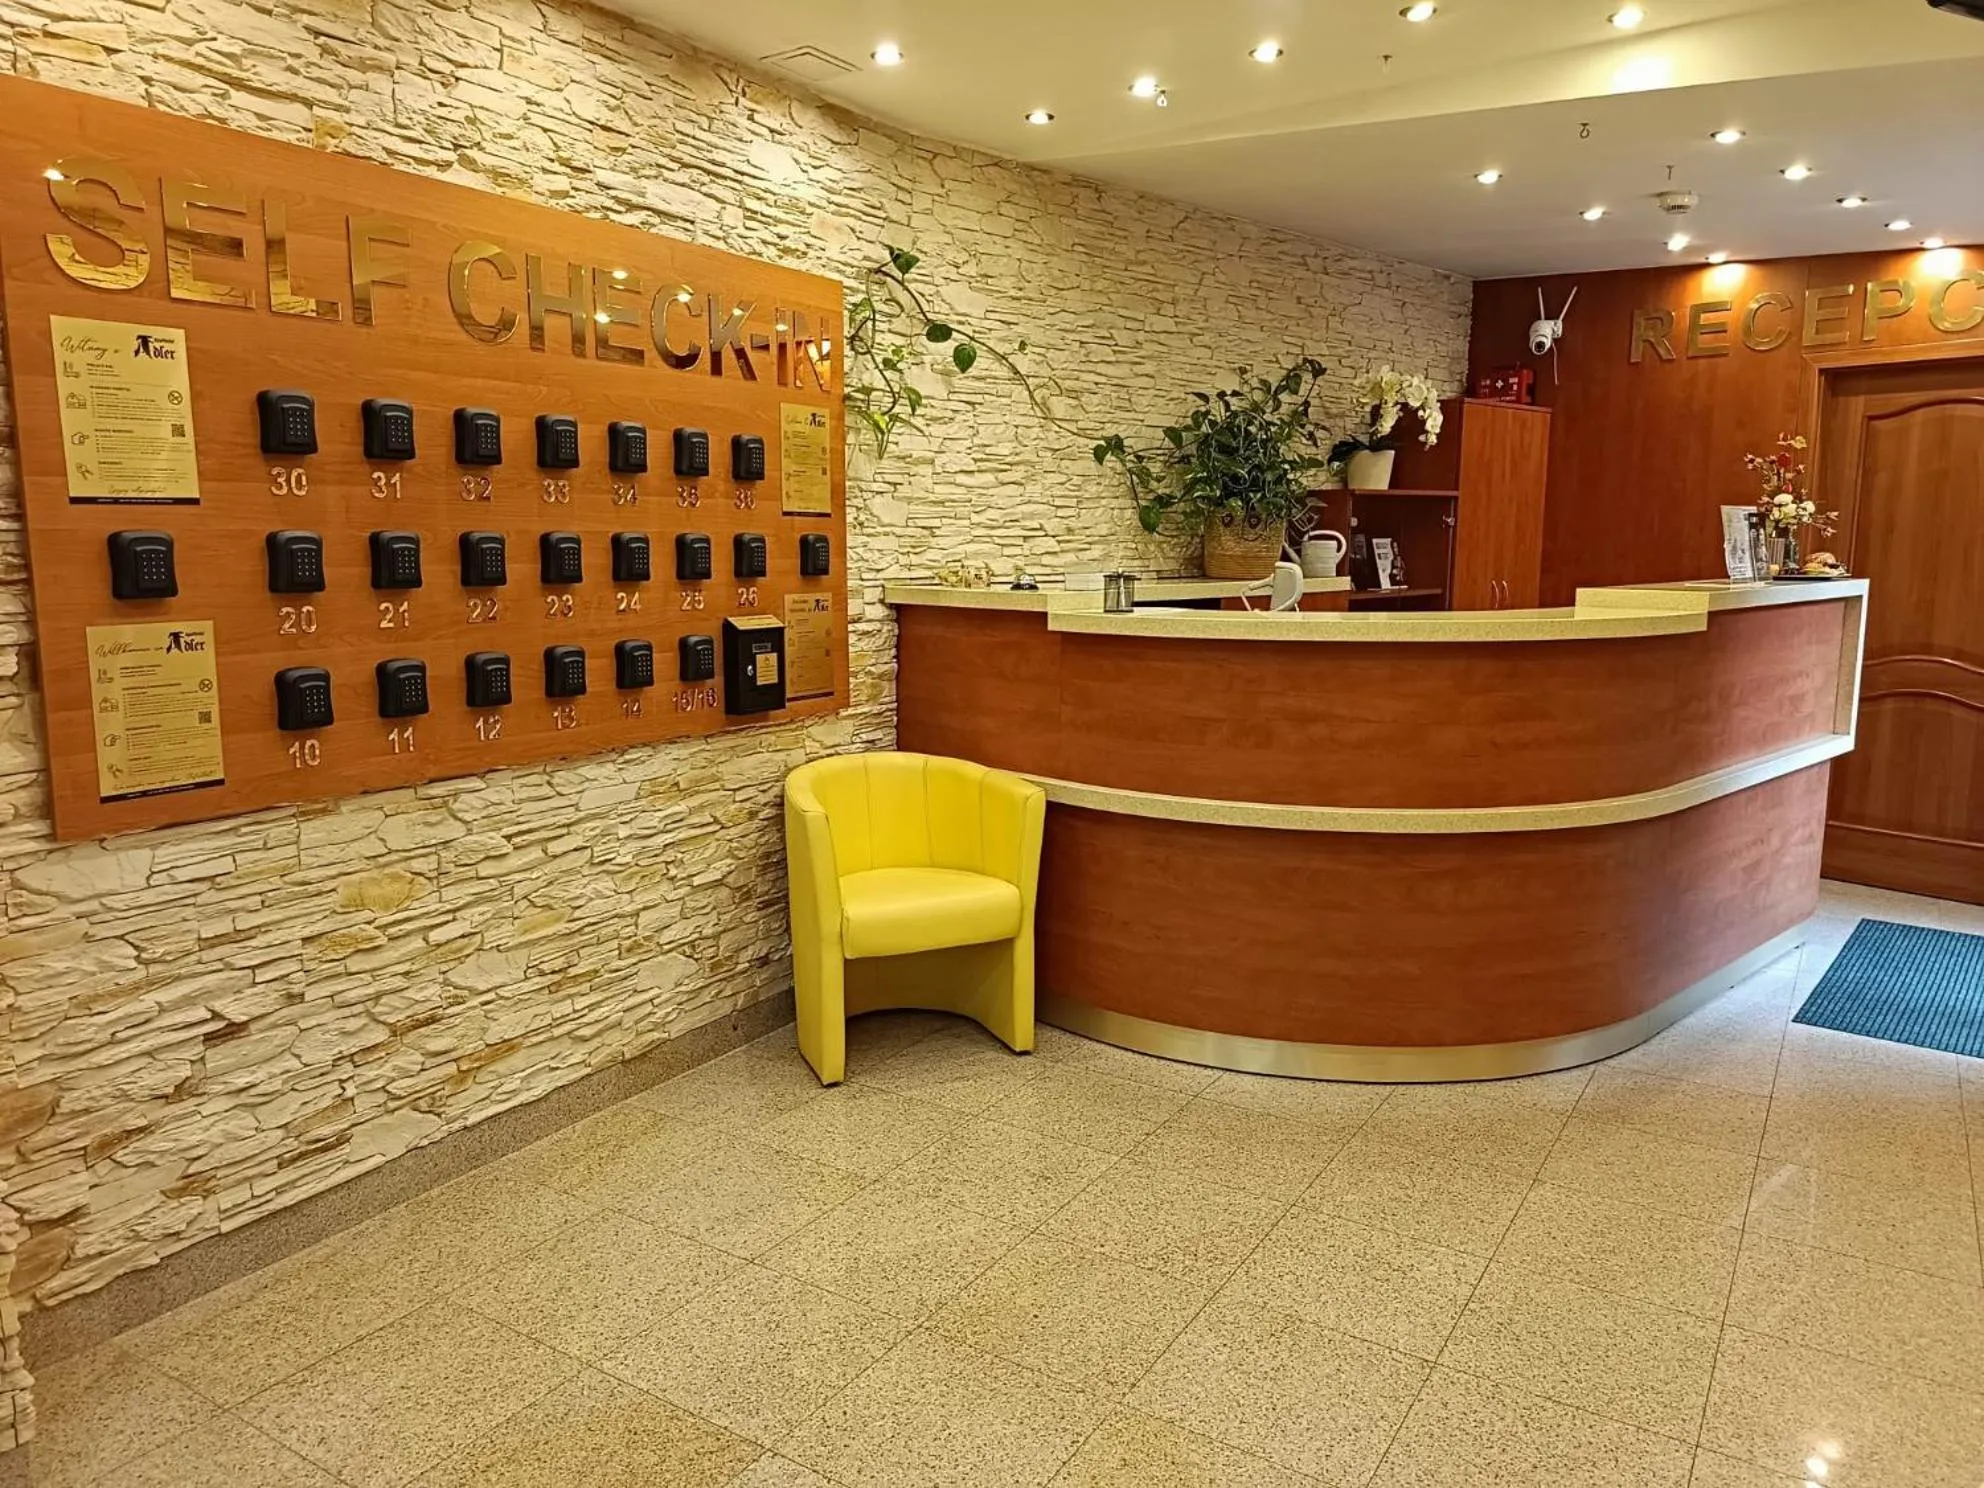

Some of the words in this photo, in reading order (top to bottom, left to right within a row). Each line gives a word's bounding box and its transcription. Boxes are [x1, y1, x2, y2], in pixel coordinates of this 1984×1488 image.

[45, 156, 412, 327] SELF
[447, 240, 832, 392] CHECK-IN
[1629, 268, 1984, 364] RECEPC
[270, 466, 309, 497] 30
[370, 471, 401, 499] 31
[460, 475, 493, 502] 32
[542, 478, 571, 504] 33
[612, 481, 639, 506] 34
[676, 484, 701, 508] 35
[545, 594, 574, 618] 23
[615, 591, 642, 614] 24
[679, 590, 705, 612] 25
[736, 586, 759, 608] 26
[278, 604, 318, 635] 20
[377, 600, 410, 630] 21
[466, 598, 499, 624] 22
[551, 703, 578, 731] 13
[621, 698, 644, 720] 14
[388, 726, 415, 755] 11
[475, 715, 502, 741] 12
[288, 738, 321, 769] 10
